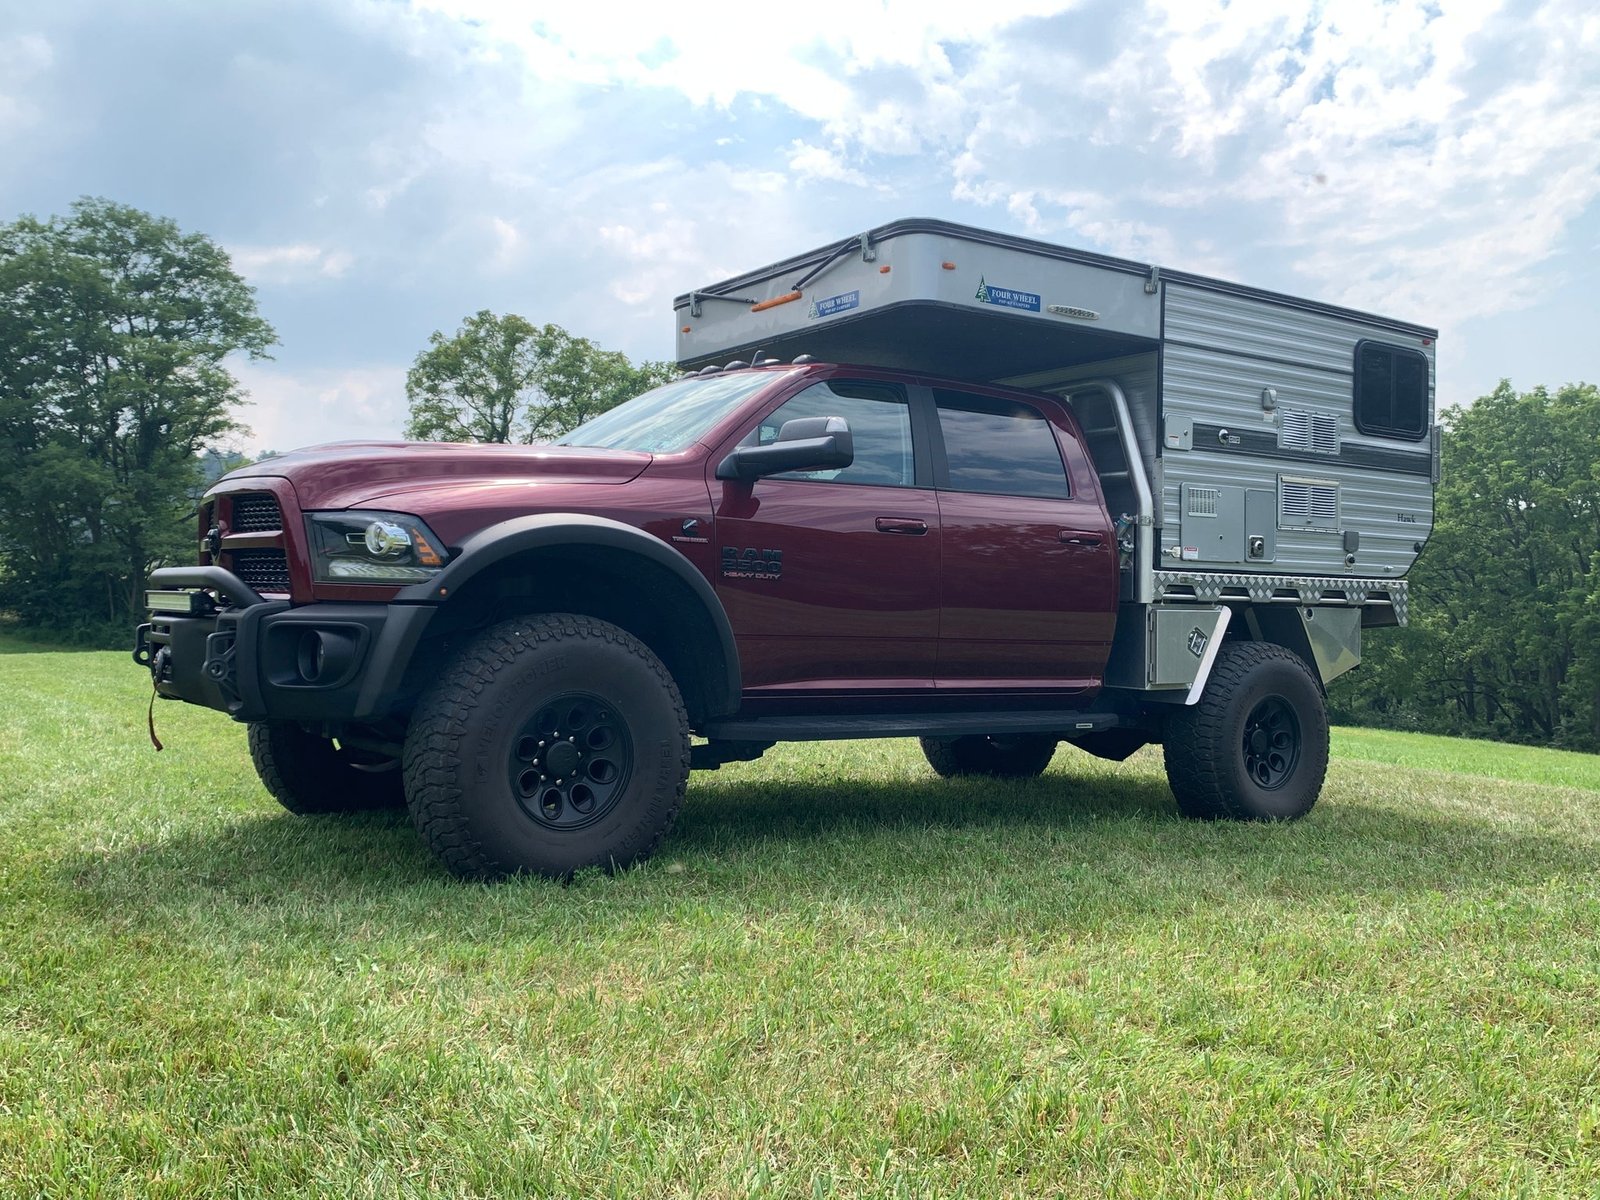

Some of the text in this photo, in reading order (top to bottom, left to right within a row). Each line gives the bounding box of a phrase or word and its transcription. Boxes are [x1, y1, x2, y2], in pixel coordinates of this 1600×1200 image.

[820, 293, 857, 310] FOUR WHEEL
[991, 289, 1037, 304] FOUR WHEEL
[1397, 513, 1416, 523] Hawk
[722, 546, 782, 560] RAM
[722, 559, 782, 571] 2500
